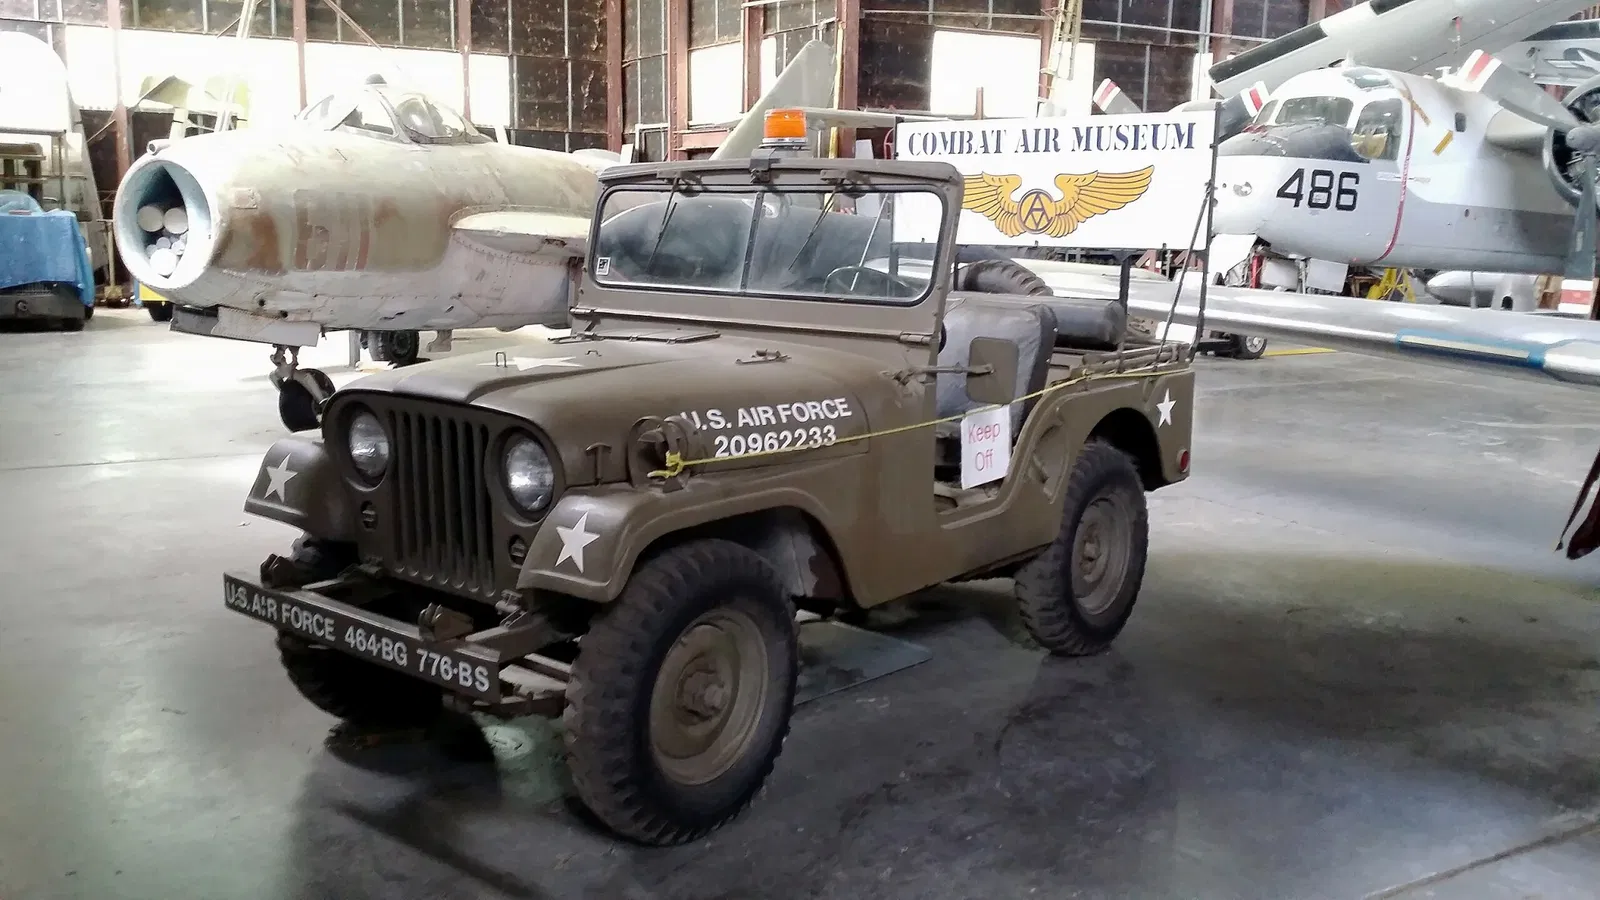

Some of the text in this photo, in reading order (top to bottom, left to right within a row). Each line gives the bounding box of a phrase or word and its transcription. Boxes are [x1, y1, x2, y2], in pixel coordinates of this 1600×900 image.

[907, 122, 1196, 156] COMBAT AIR MUSEUM
[1276, 168, 1360, 211] 486
[738, 405, 777, 428] AIR
[776, 397, 852, 424] FORCE
[714, 424, 837, 458] 20962233
[968, 423, 1001, 444] Keep
[975, 448, 994, 472] Off
[251, 593, 278, 621] AIR
[281, 602, 337, 642] FORCE
